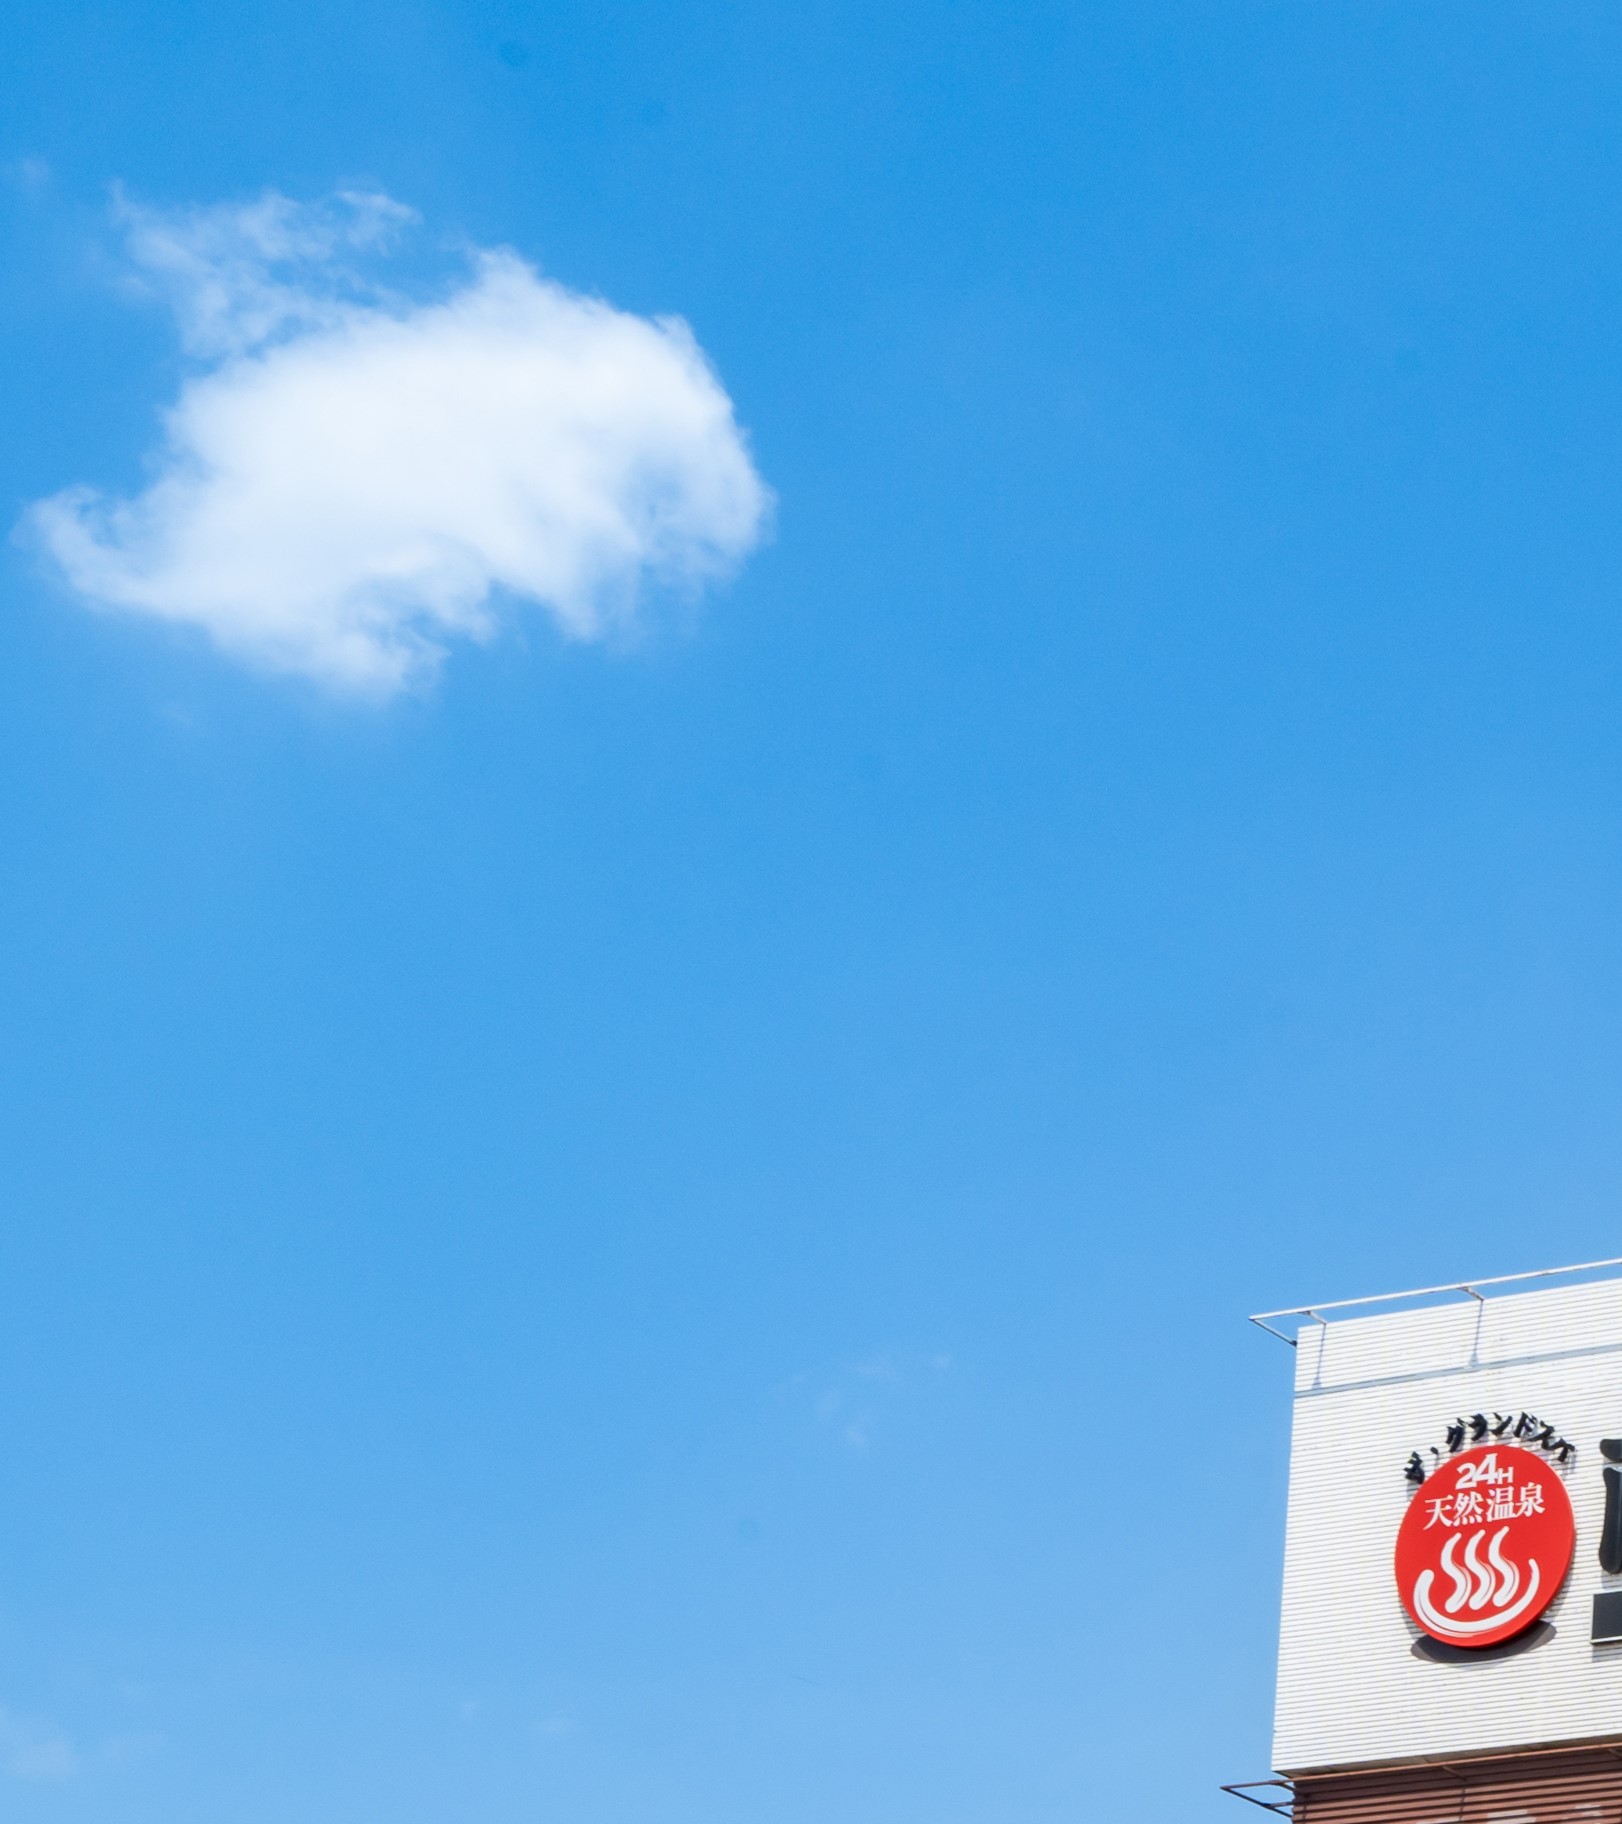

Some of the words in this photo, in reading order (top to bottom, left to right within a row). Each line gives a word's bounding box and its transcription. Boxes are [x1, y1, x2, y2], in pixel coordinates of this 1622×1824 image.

[1455, 1453, 1514, 1489] 24H
[1423, 1482, 1545, 1531] 天然温泉
